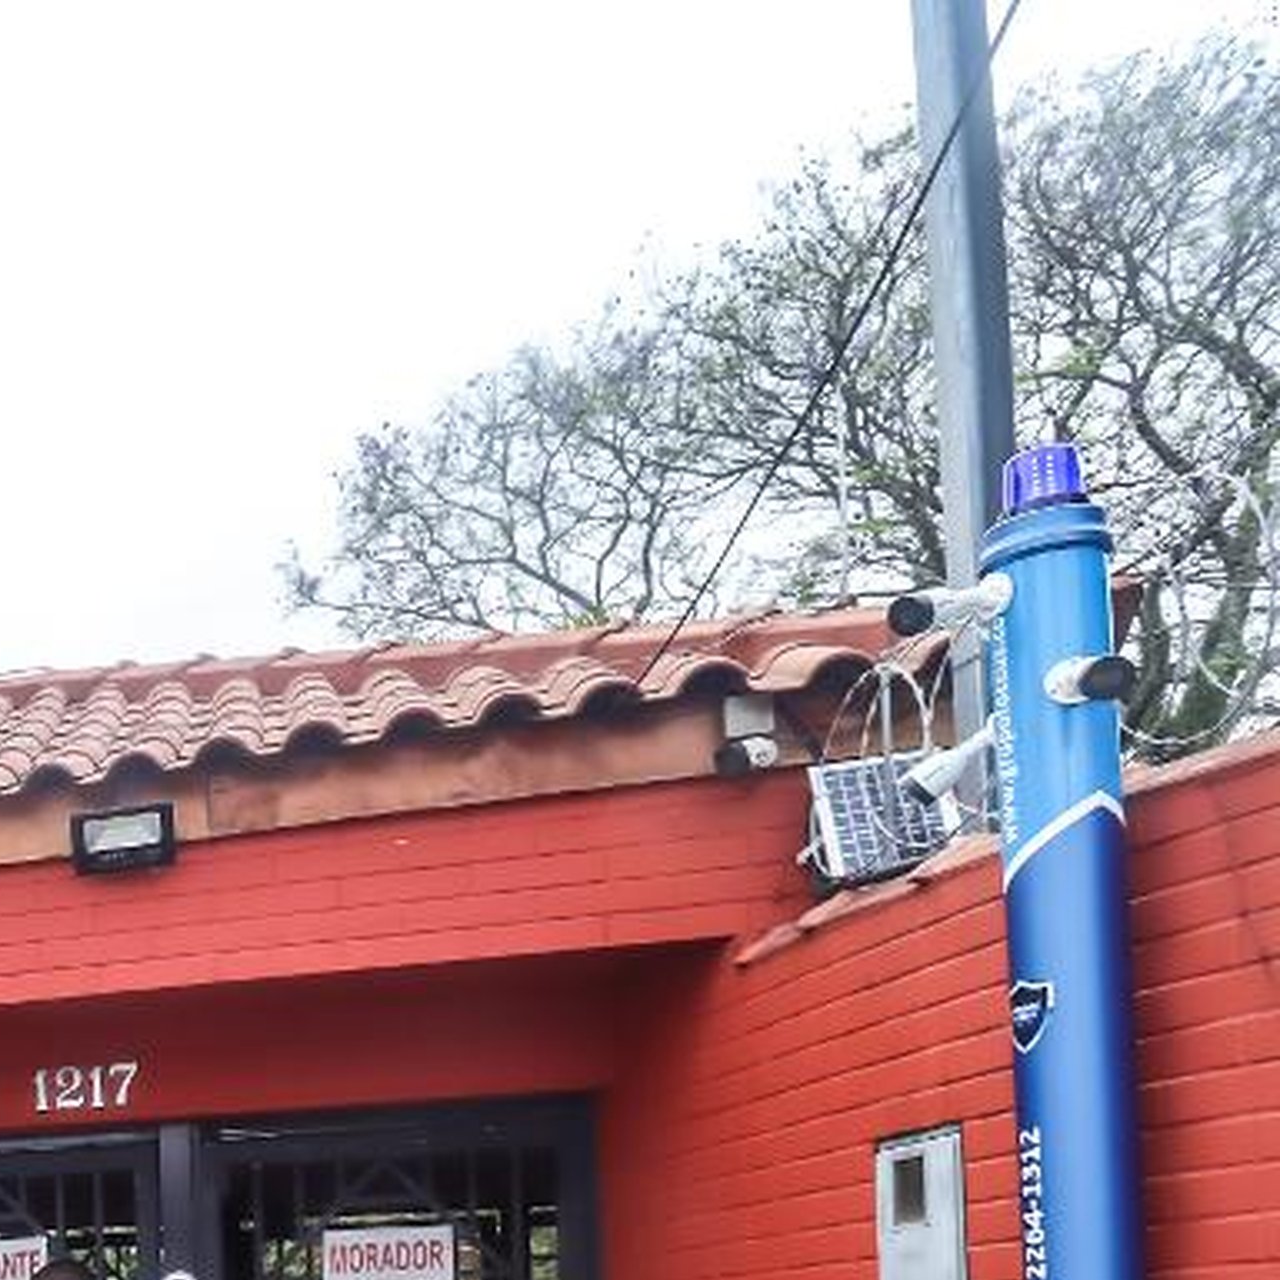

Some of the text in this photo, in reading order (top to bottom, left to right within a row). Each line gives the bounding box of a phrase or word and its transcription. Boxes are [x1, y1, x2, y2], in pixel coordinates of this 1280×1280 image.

[33, 1060, 139, 1113] 1217
[1020, 1126, 1048, 1280] 2264-1312
[329, 1239, 445, 1275] MORADOR
